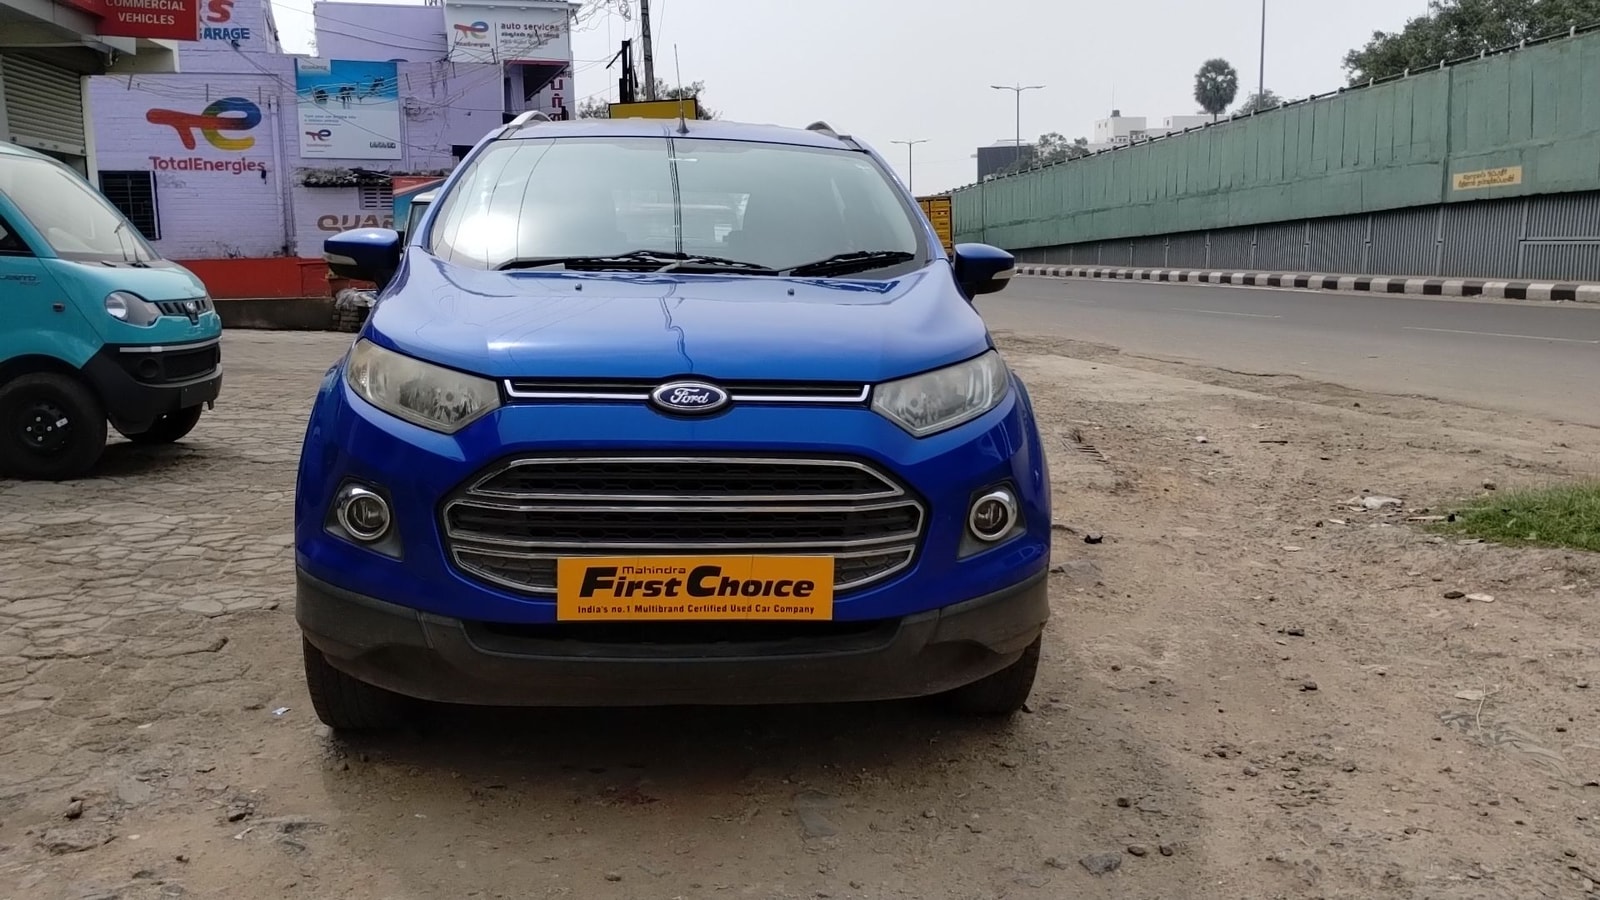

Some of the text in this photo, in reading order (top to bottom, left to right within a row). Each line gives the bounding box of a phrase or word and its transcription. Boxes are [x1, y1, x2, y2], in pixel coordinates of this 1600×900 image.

[105, 0, 186, 12] COMMERCIAL
[118, 12, 175, 25] VEHICLES
[501, 22, 560, 32] auto services
[148, 156, 266, 175] TotalEnergies
[670, 387, 710, 404] Ford
[622, 565, 687, 575] Mahindra
[579, 565, 815, 598] First Choice
[577, 605, 608, 614] India's
[634, 604, 685, 613] Multibrand
[687, 604, 727, 613] Certified
[730, 604, 752, 613] Used
[755, 604, 771, 613] Car
[773, 604, 815, 615] Company
